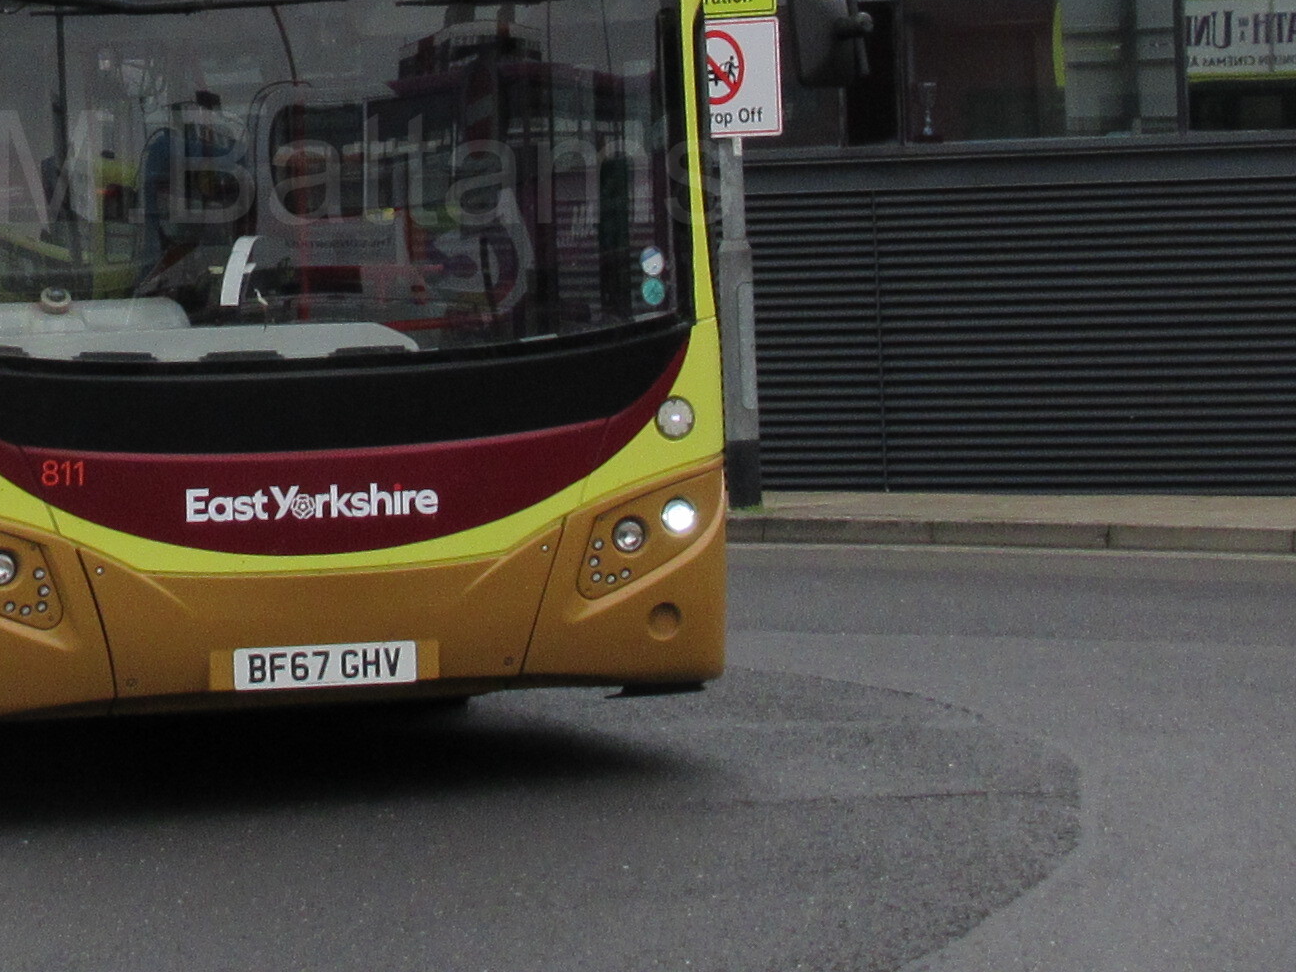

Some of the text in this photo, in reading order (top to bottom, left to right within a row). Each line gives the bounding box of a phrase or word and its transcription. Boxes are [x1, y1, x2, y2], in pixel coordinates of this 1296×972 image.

[738, 107, 763, 124] Off
[41, 459, 86, 487] 811
[185, 487, 268, 523] East
[248, 646, 402, 685] BF67 GHV
